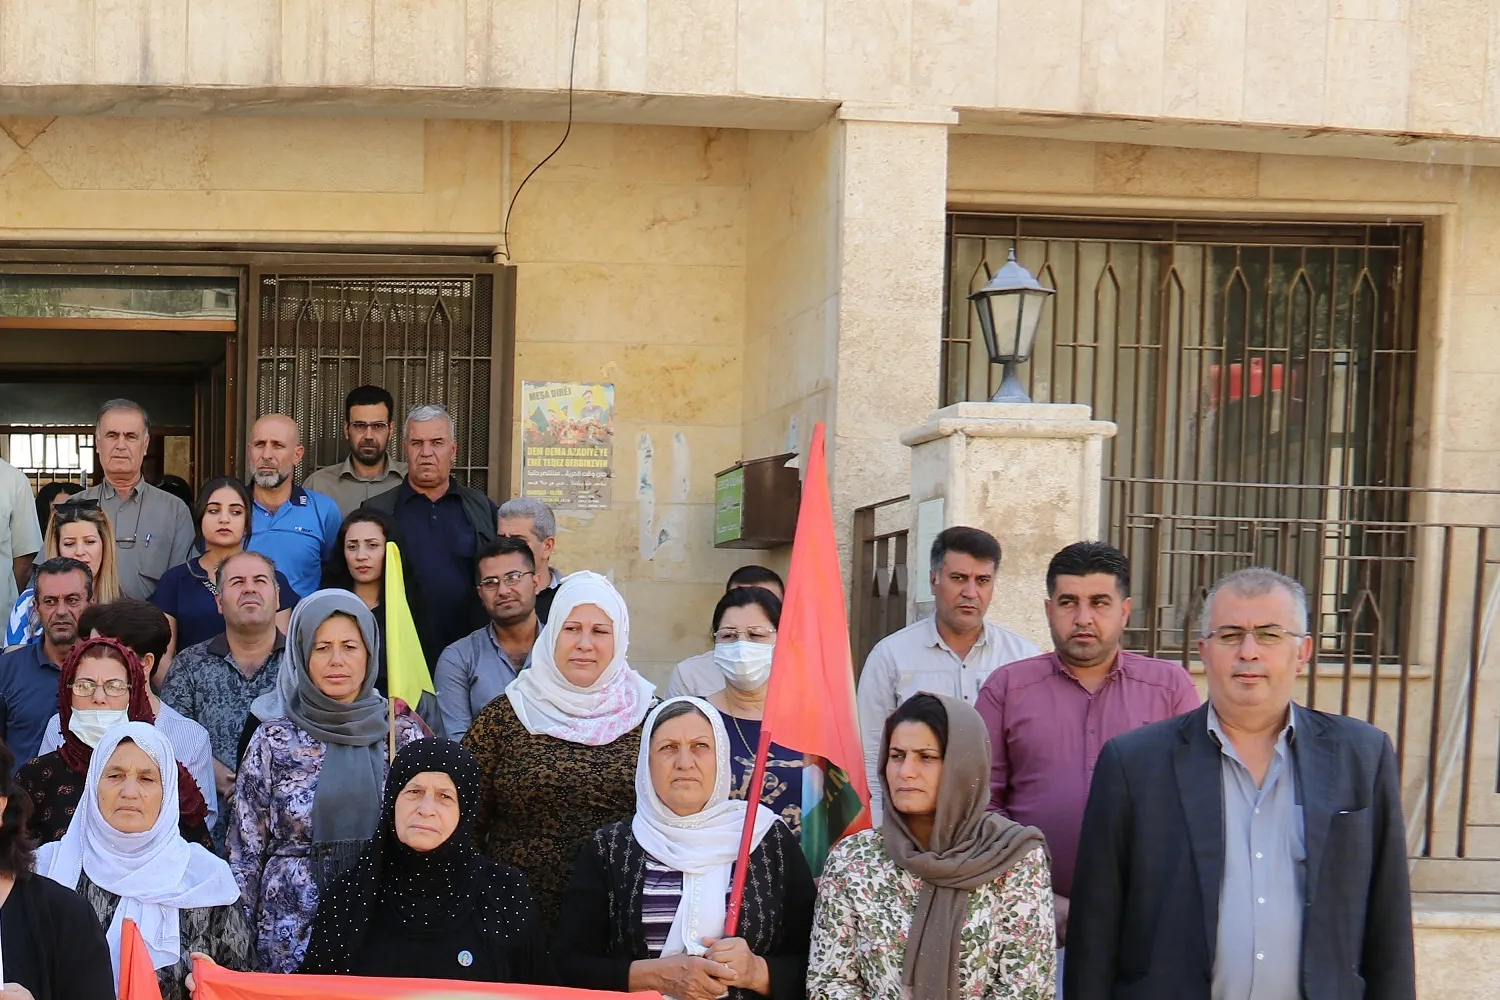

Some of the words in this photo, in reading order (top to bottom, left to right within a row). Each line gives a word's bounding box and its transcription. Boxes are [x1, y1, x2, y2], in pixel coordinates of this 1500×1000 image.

[528, 389, 550, 401] MEŞA
[527, 447, 543, 456] DEM
[544, 447, 566, 456] DEMA
